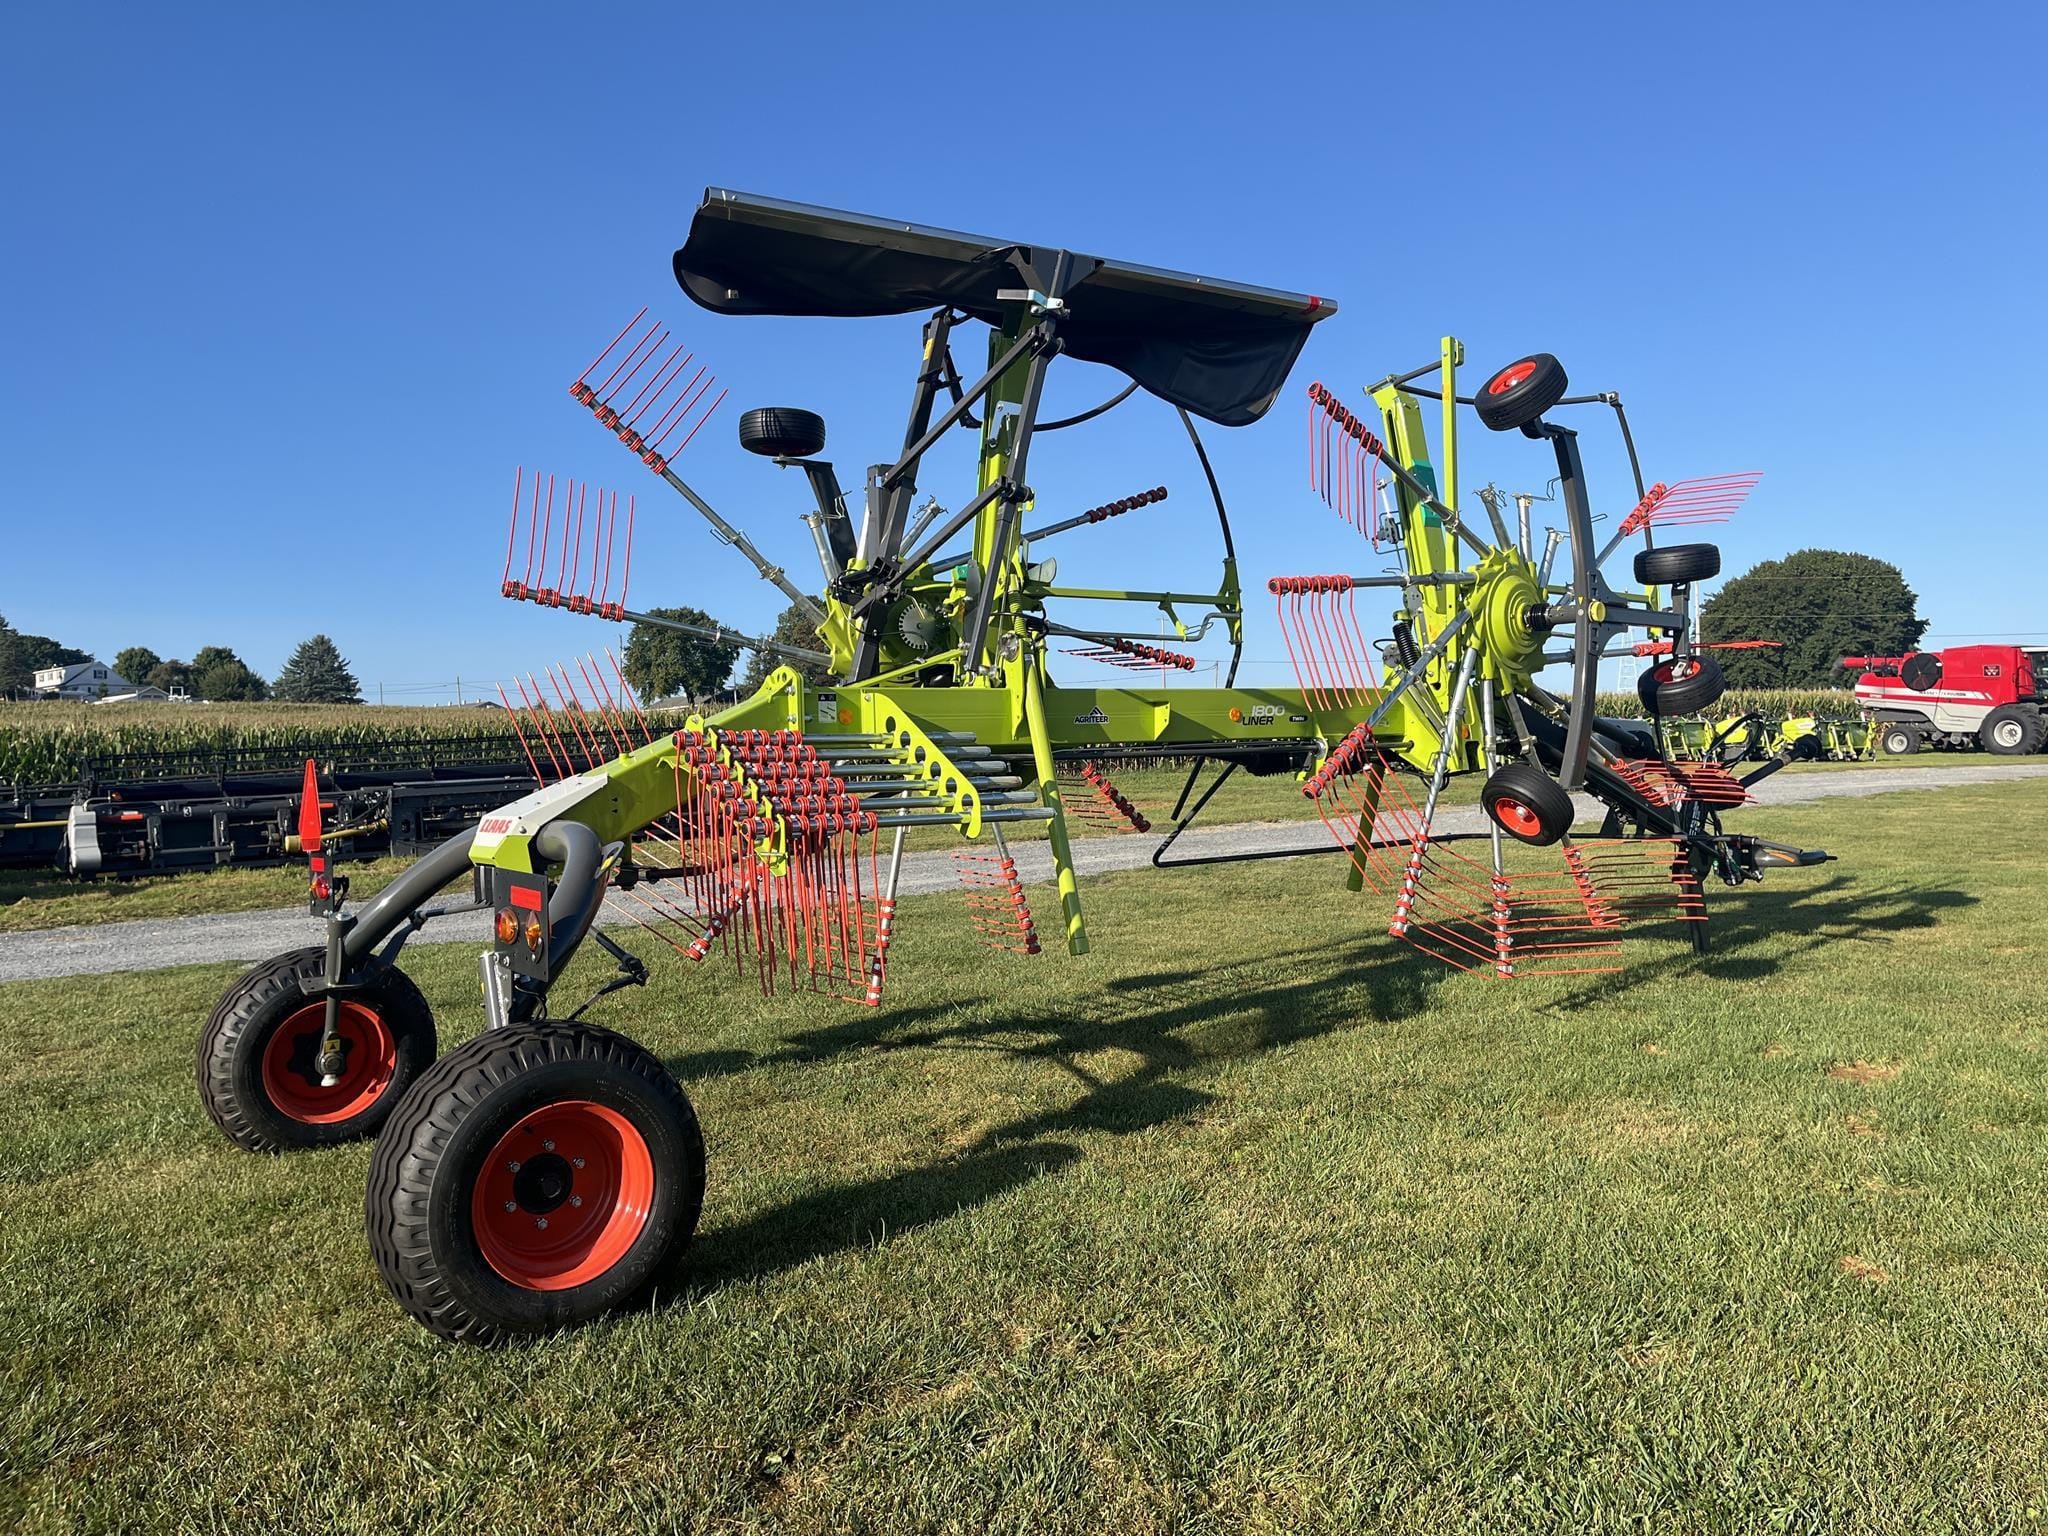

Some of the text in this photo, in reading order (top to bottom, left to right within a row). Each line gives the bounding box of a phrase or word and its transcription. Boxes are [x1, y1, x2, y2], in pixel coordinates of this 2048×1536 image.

[1251, 704, 1285, 717] 1800
[1074, 715, 1109, 723] AGRITEER
[1242, 716, 1274, 726] LINER
[479, 819, 513, 834] CLAAS
